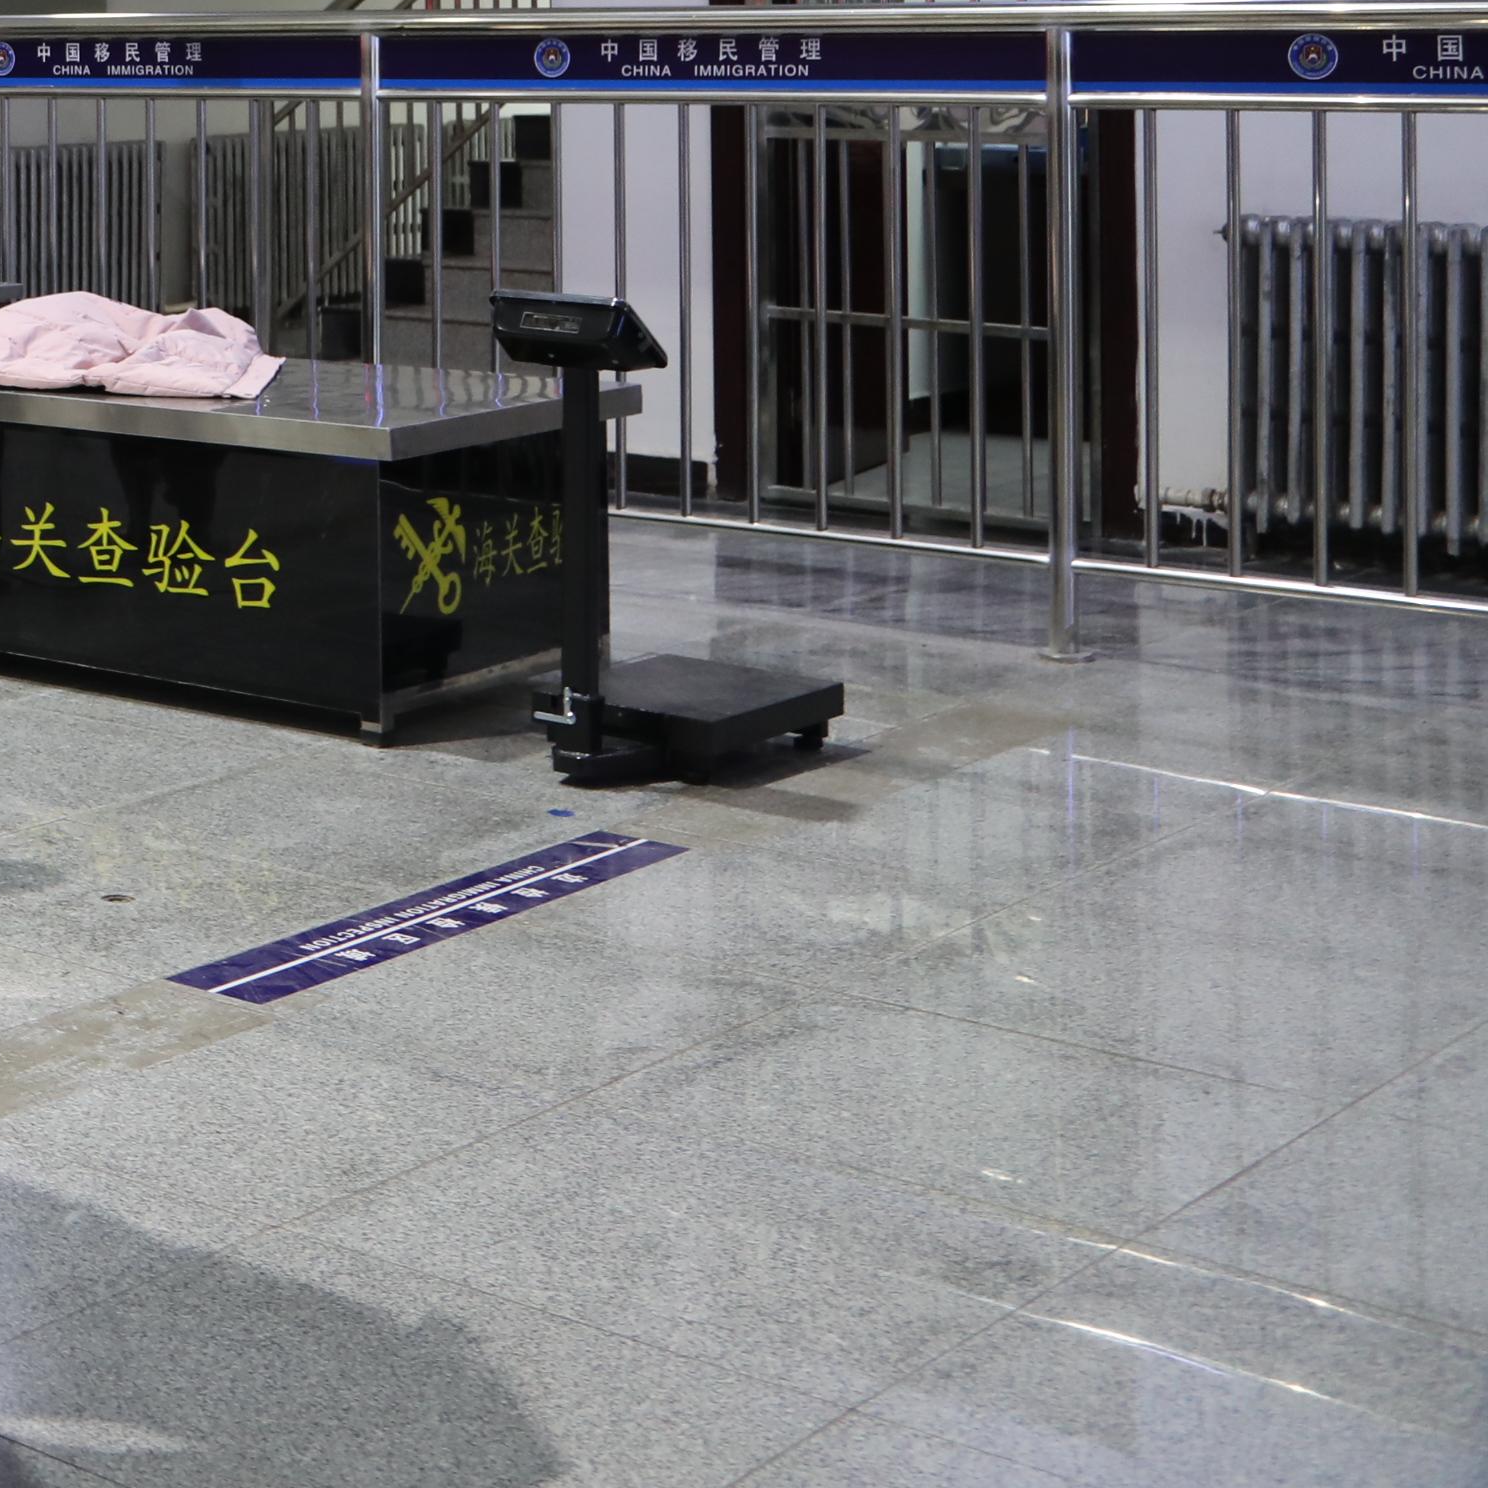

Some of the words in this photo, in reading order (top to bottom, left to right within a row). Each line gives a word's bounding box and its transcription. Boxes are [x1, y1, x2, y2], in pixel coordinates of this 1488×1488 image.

[37, 41, 202, 63] 中国移民管理
[600, 37, 822, 62] 中国移民管理
[53, 64, 91, 76] CHINA
[107, 64, 194, 76] IMMIGRATION
[621, 64, 672, 77] CHINA
[694, 64, 809, 77] IMMIGRATION
[1412, 65, 1485, 80] CHINA
[494, 865, 546, 883] CHINA
[394, 881, 501, 918] IMMIGRATION
[299, 916, 400, 951] INSPECTION
